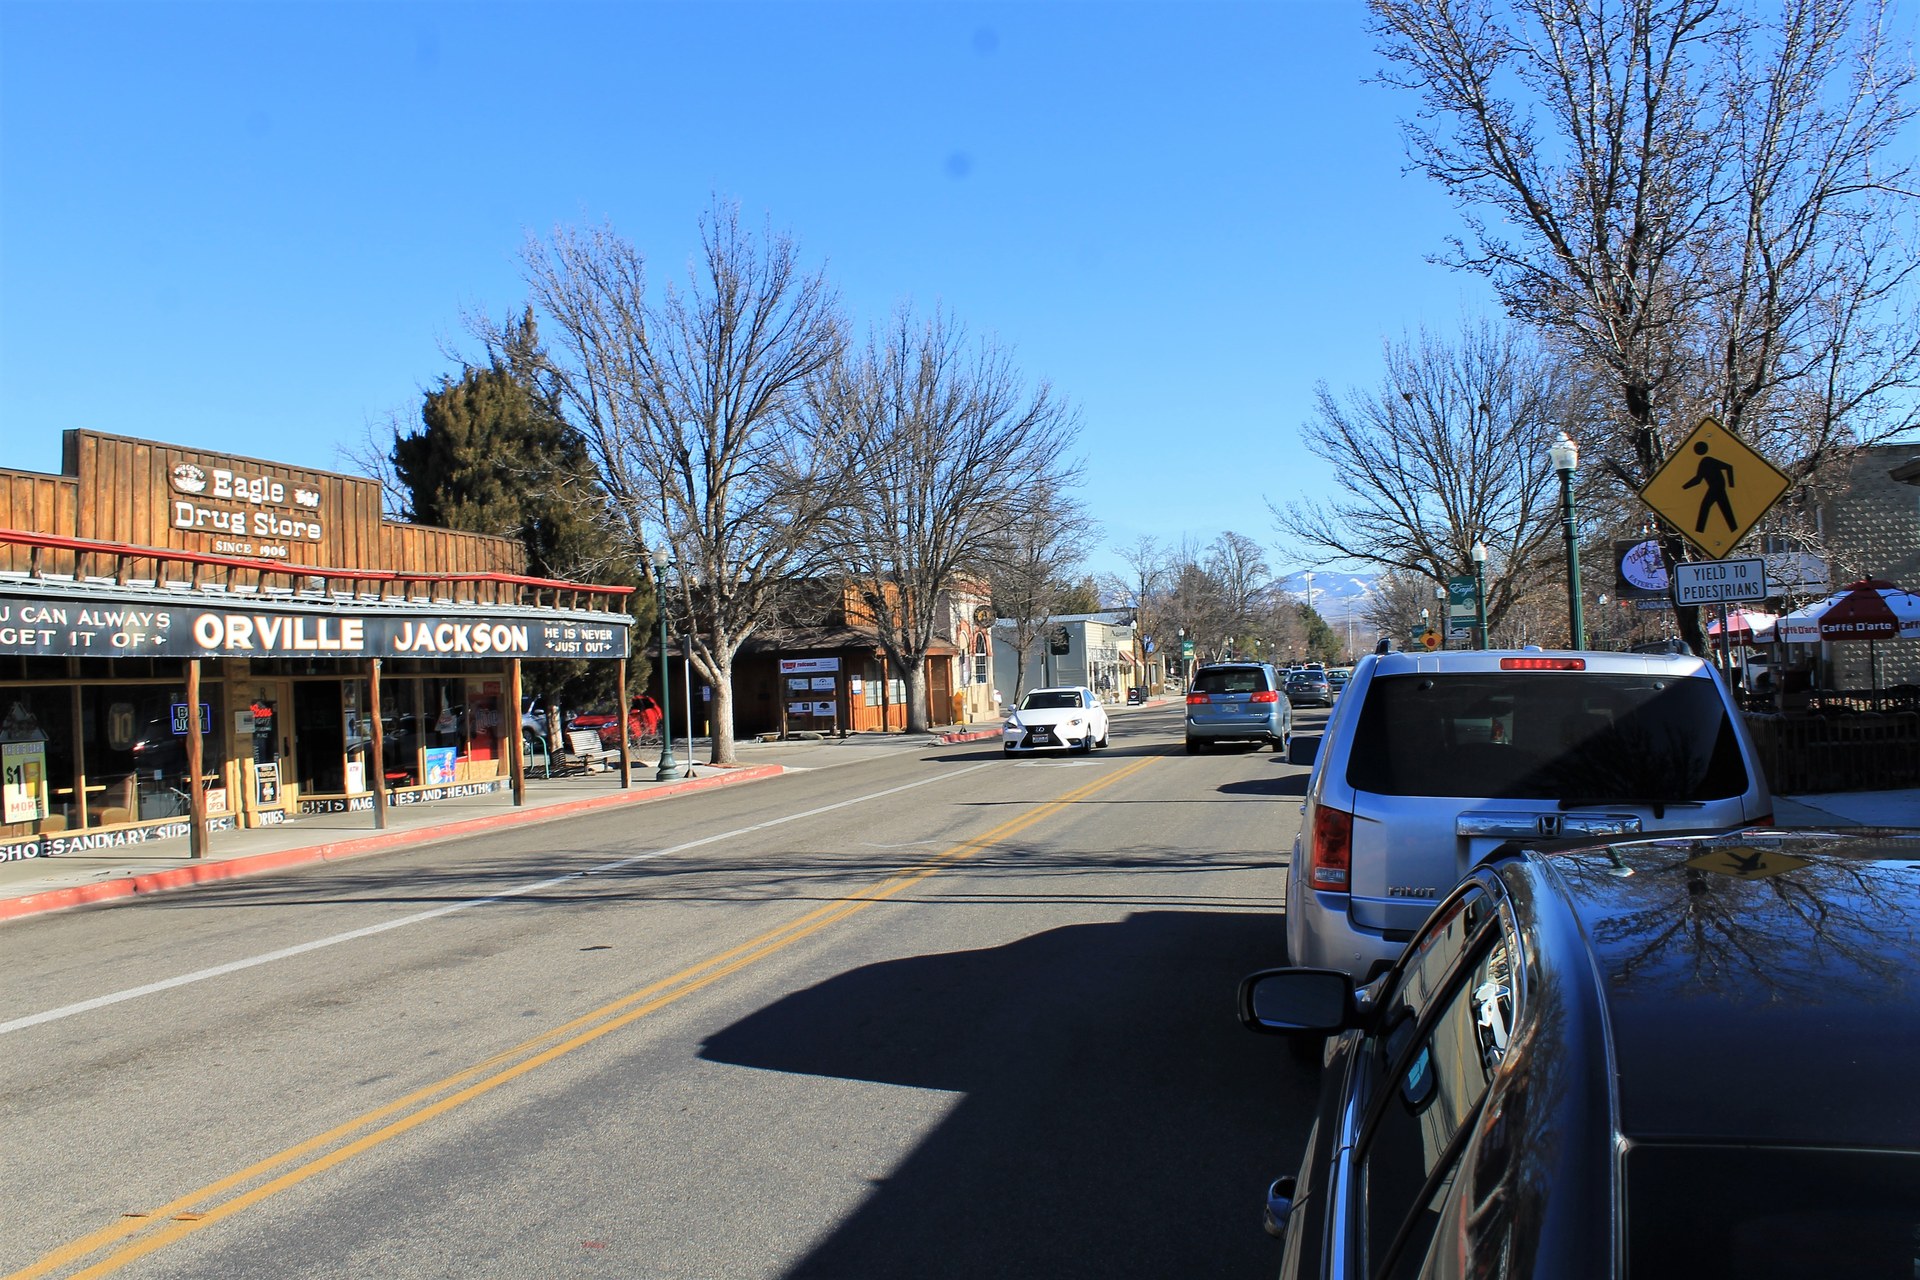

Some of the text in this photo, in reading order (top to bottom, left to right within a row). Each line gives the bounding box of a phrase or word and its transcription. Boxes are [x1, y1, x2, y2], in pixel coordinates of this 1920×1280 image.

[212, 469, 285, 504] Eagle
[175, 501, 321, 539] Drug Store
[215, 540, 286, 558] SINCE 1906
[1693, 564, 1747, 581] YIELD TO
[1684, 582, 1759, 599] PEDESTRIANS
[20, 607, 68, 625] CAN
[78, 609, 171, 628] ALWAYS
[0, 628, 146, 648] GET IT OF
[193, 613, 529, 653] ORVILLE JACKSON
[544, 627, 612, 640] HE IS NEVER
[554, 641, 604, 652] JUST OUT
[6, 764, 22, 795] $1
[11, 799, 43, 812] MORE
[1388, 886, 1436, 898] PILOT
